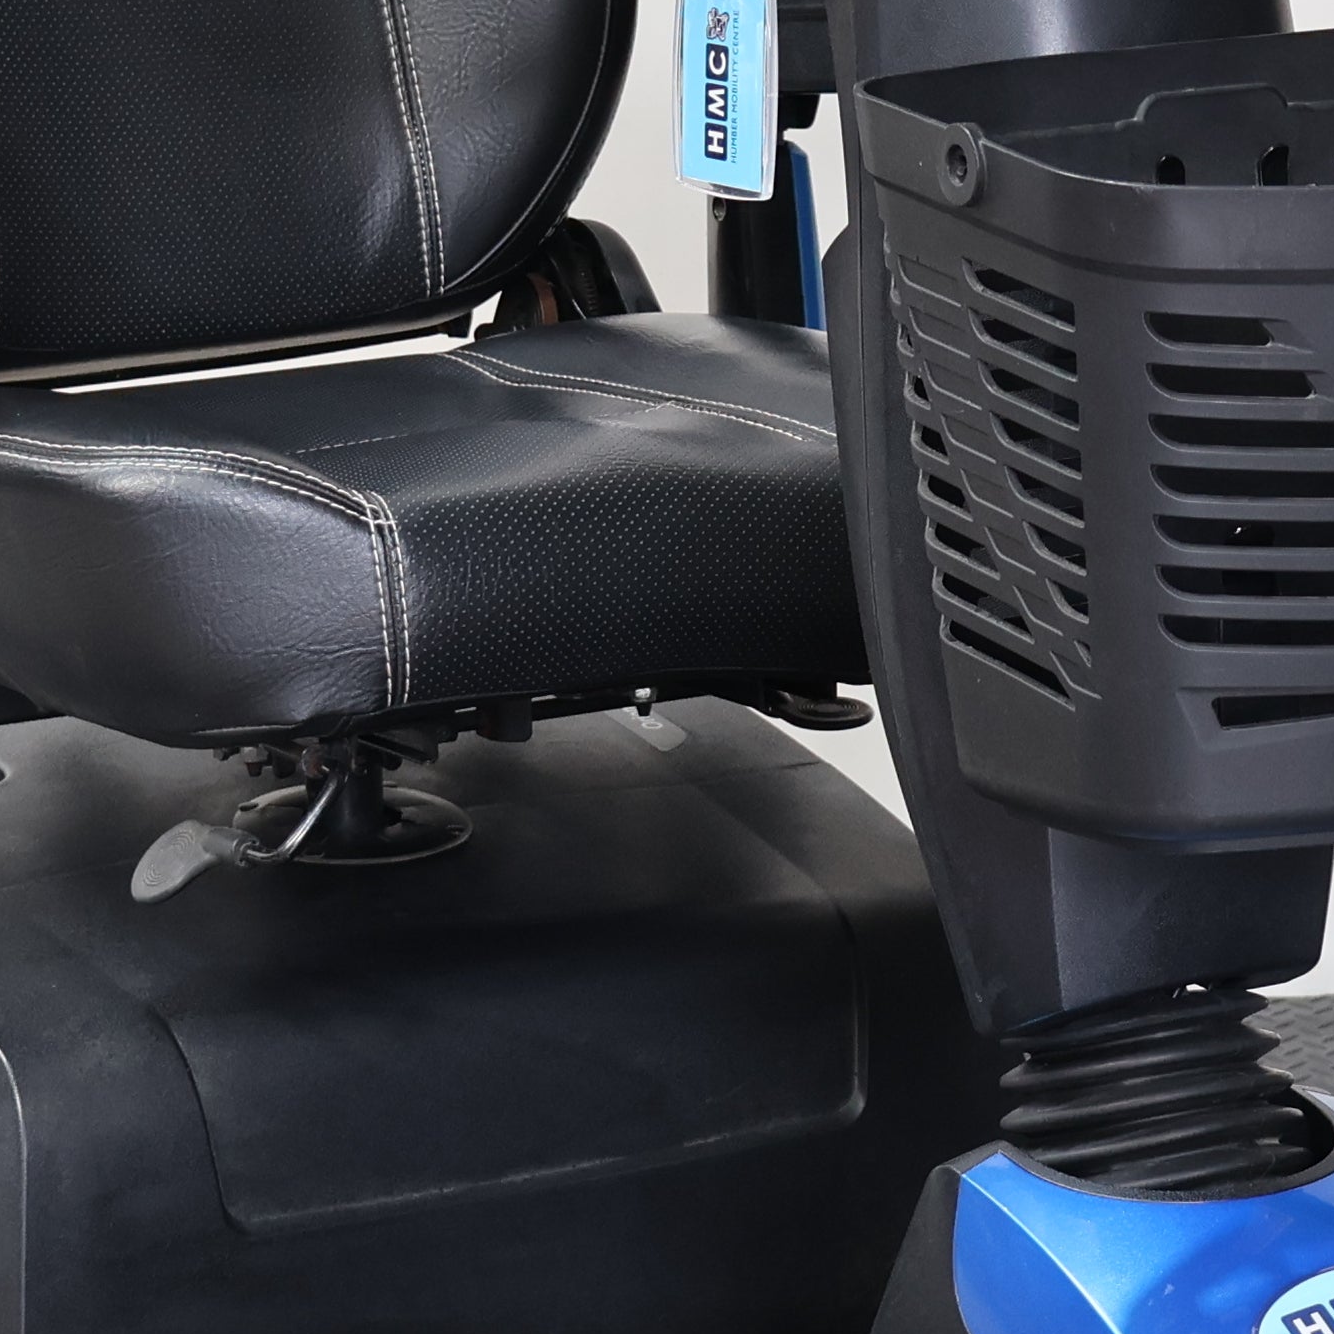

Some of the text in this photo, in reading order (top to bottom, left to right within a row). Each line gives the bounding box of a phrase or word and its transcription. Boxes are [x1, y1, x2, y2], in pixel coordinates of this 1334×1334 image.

[707, 50, 727, 155] HMC
[730, 10, 740, 164] HUMBER MOBILITY CENTRE
